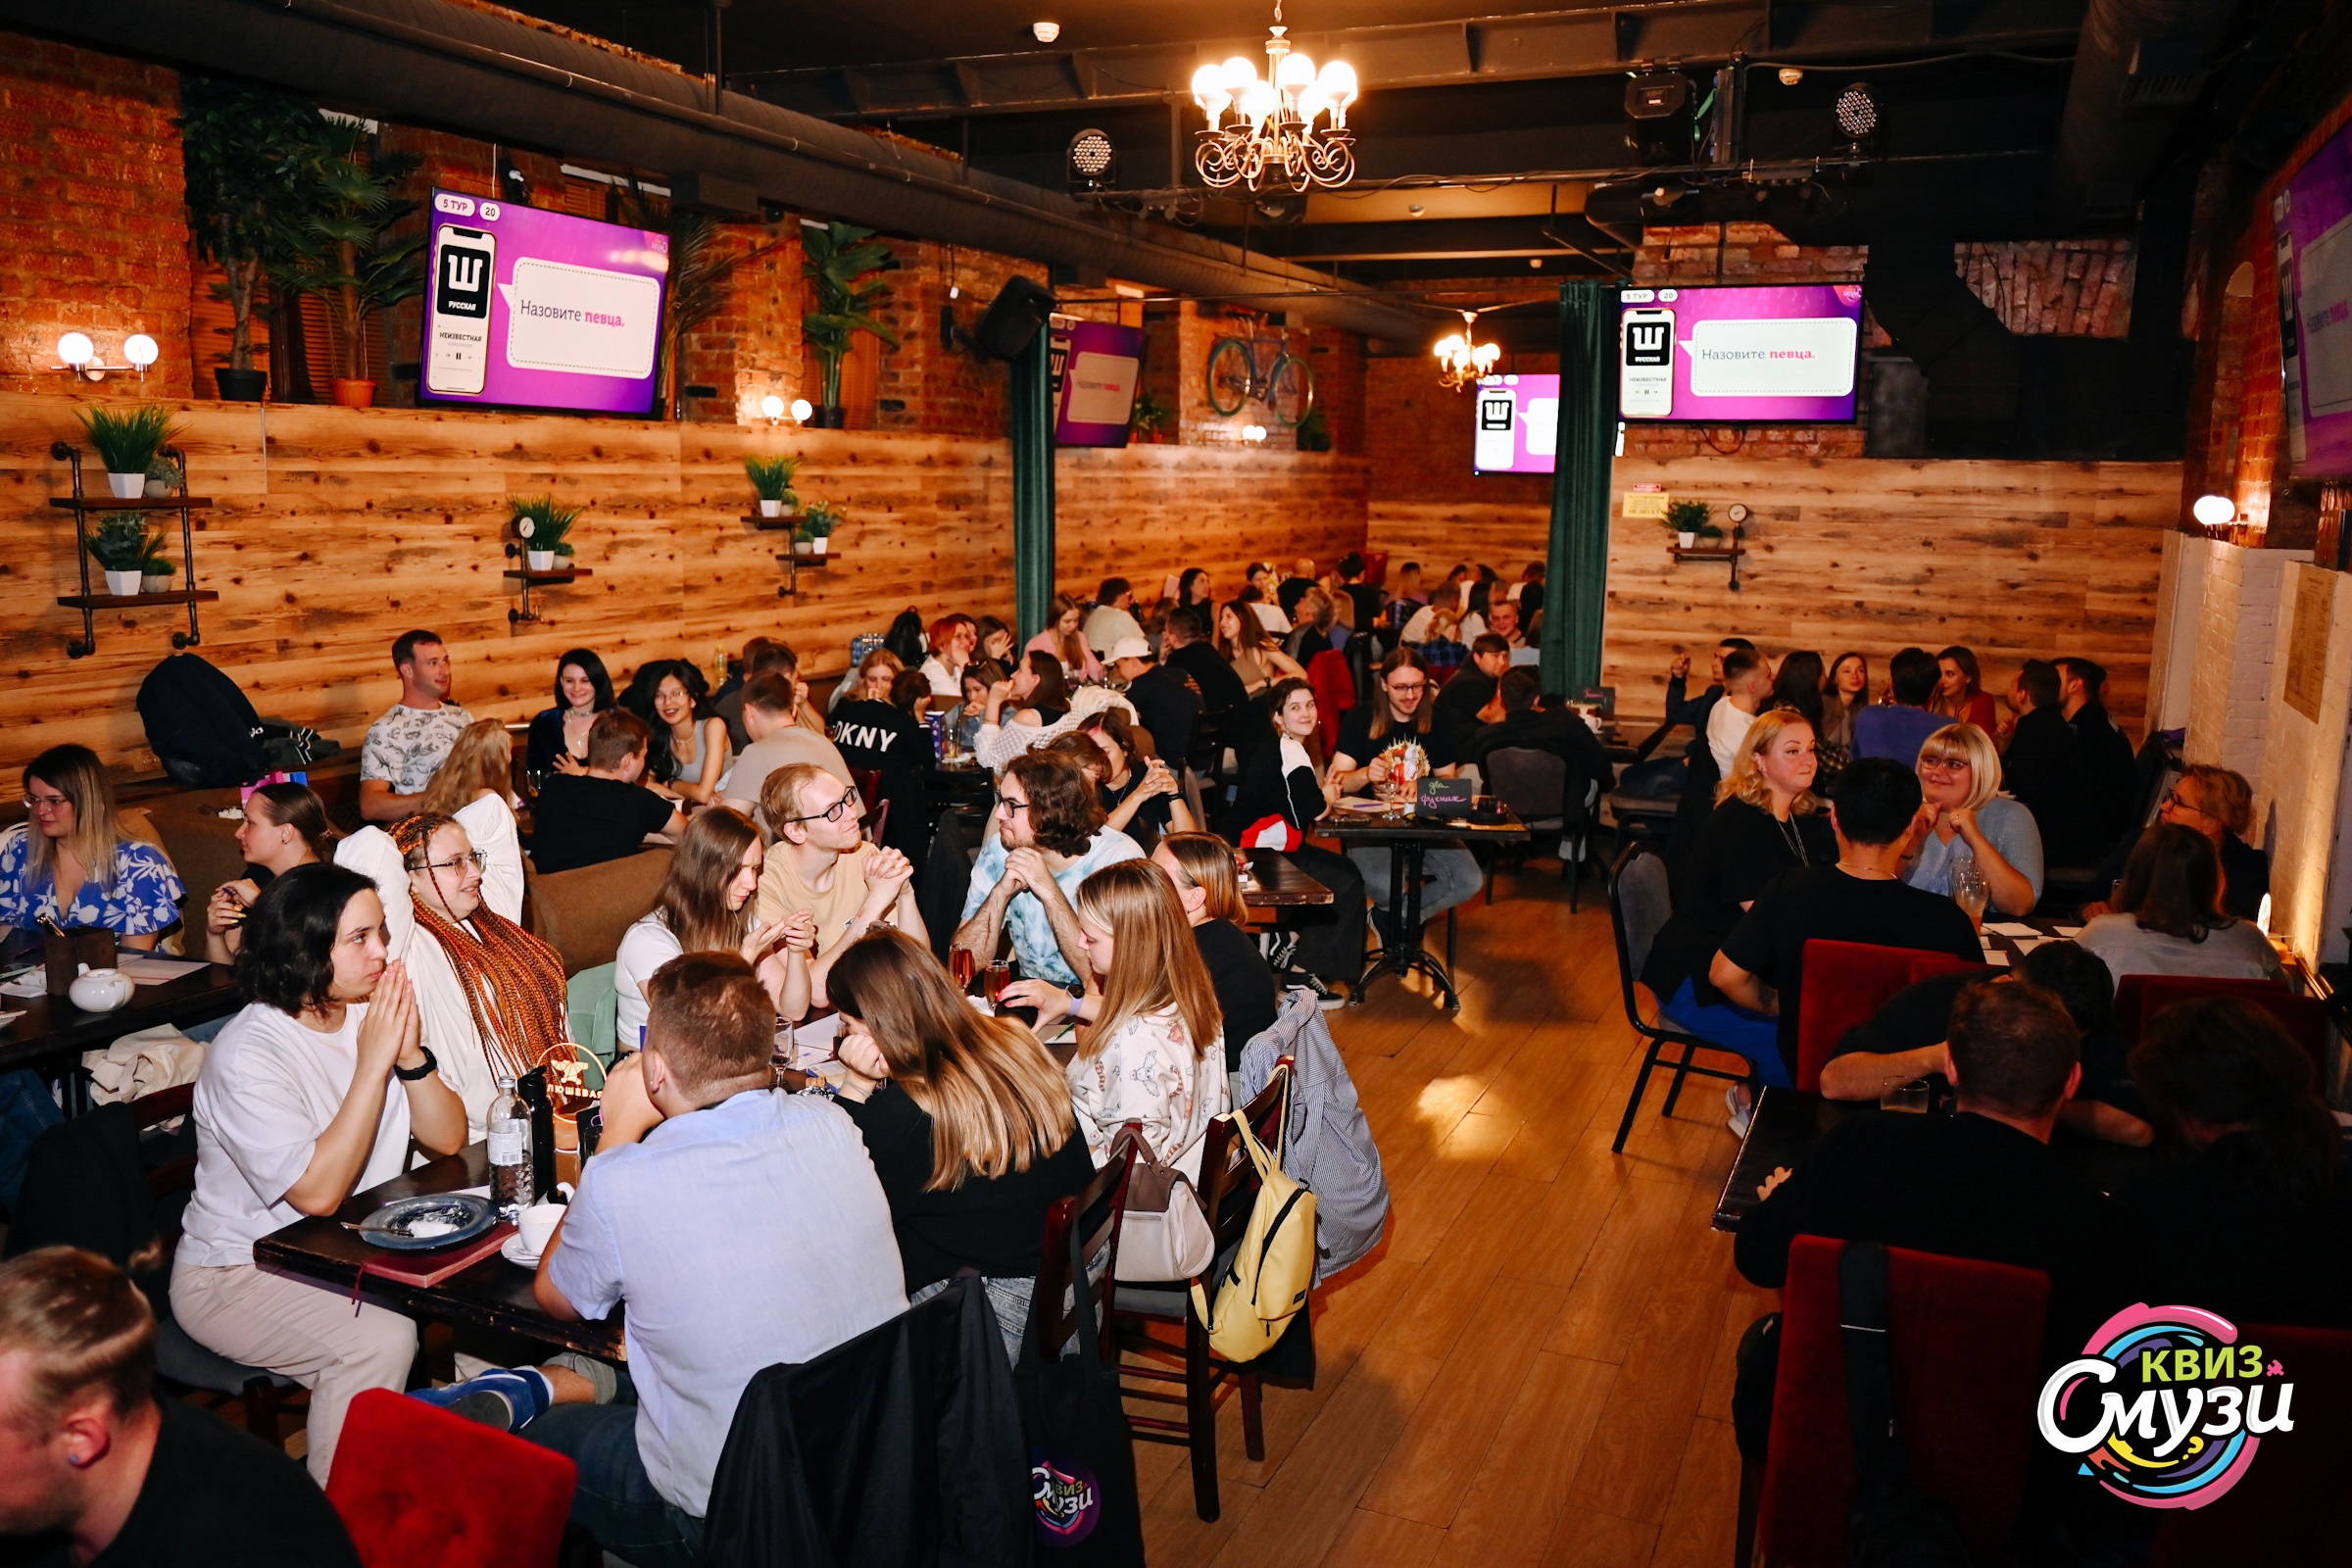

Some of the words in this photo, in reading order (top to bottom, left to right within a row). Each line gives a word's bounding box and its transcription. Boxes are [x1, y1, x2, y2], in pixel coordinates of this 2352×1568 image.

[443, 198, 449, 209] 5
[450, 200, 468, 212] ТУР
[484, 207, 496, 218] 20
[447, 254, 483, 292] Ш
[448, 300, 477, 312] РУССКАЯ
[520, 300, 581, 321] Назовите
[584, 311, 625, 327] певца.
[439, 331, 482, 343] НЕИЗВЕСТНАЯ
[1632, 326, 1665, 351] Ш
[1701, 347, 1766, 362] Назовите
[1769, 348, 1816, 363] певца.
[1485, 402, 1509, 420] Ш
[546, 1084, 604, 1100] ЛЮШЕВАЯ
[1051, 1480, 1084, 1496] ВИЗ
